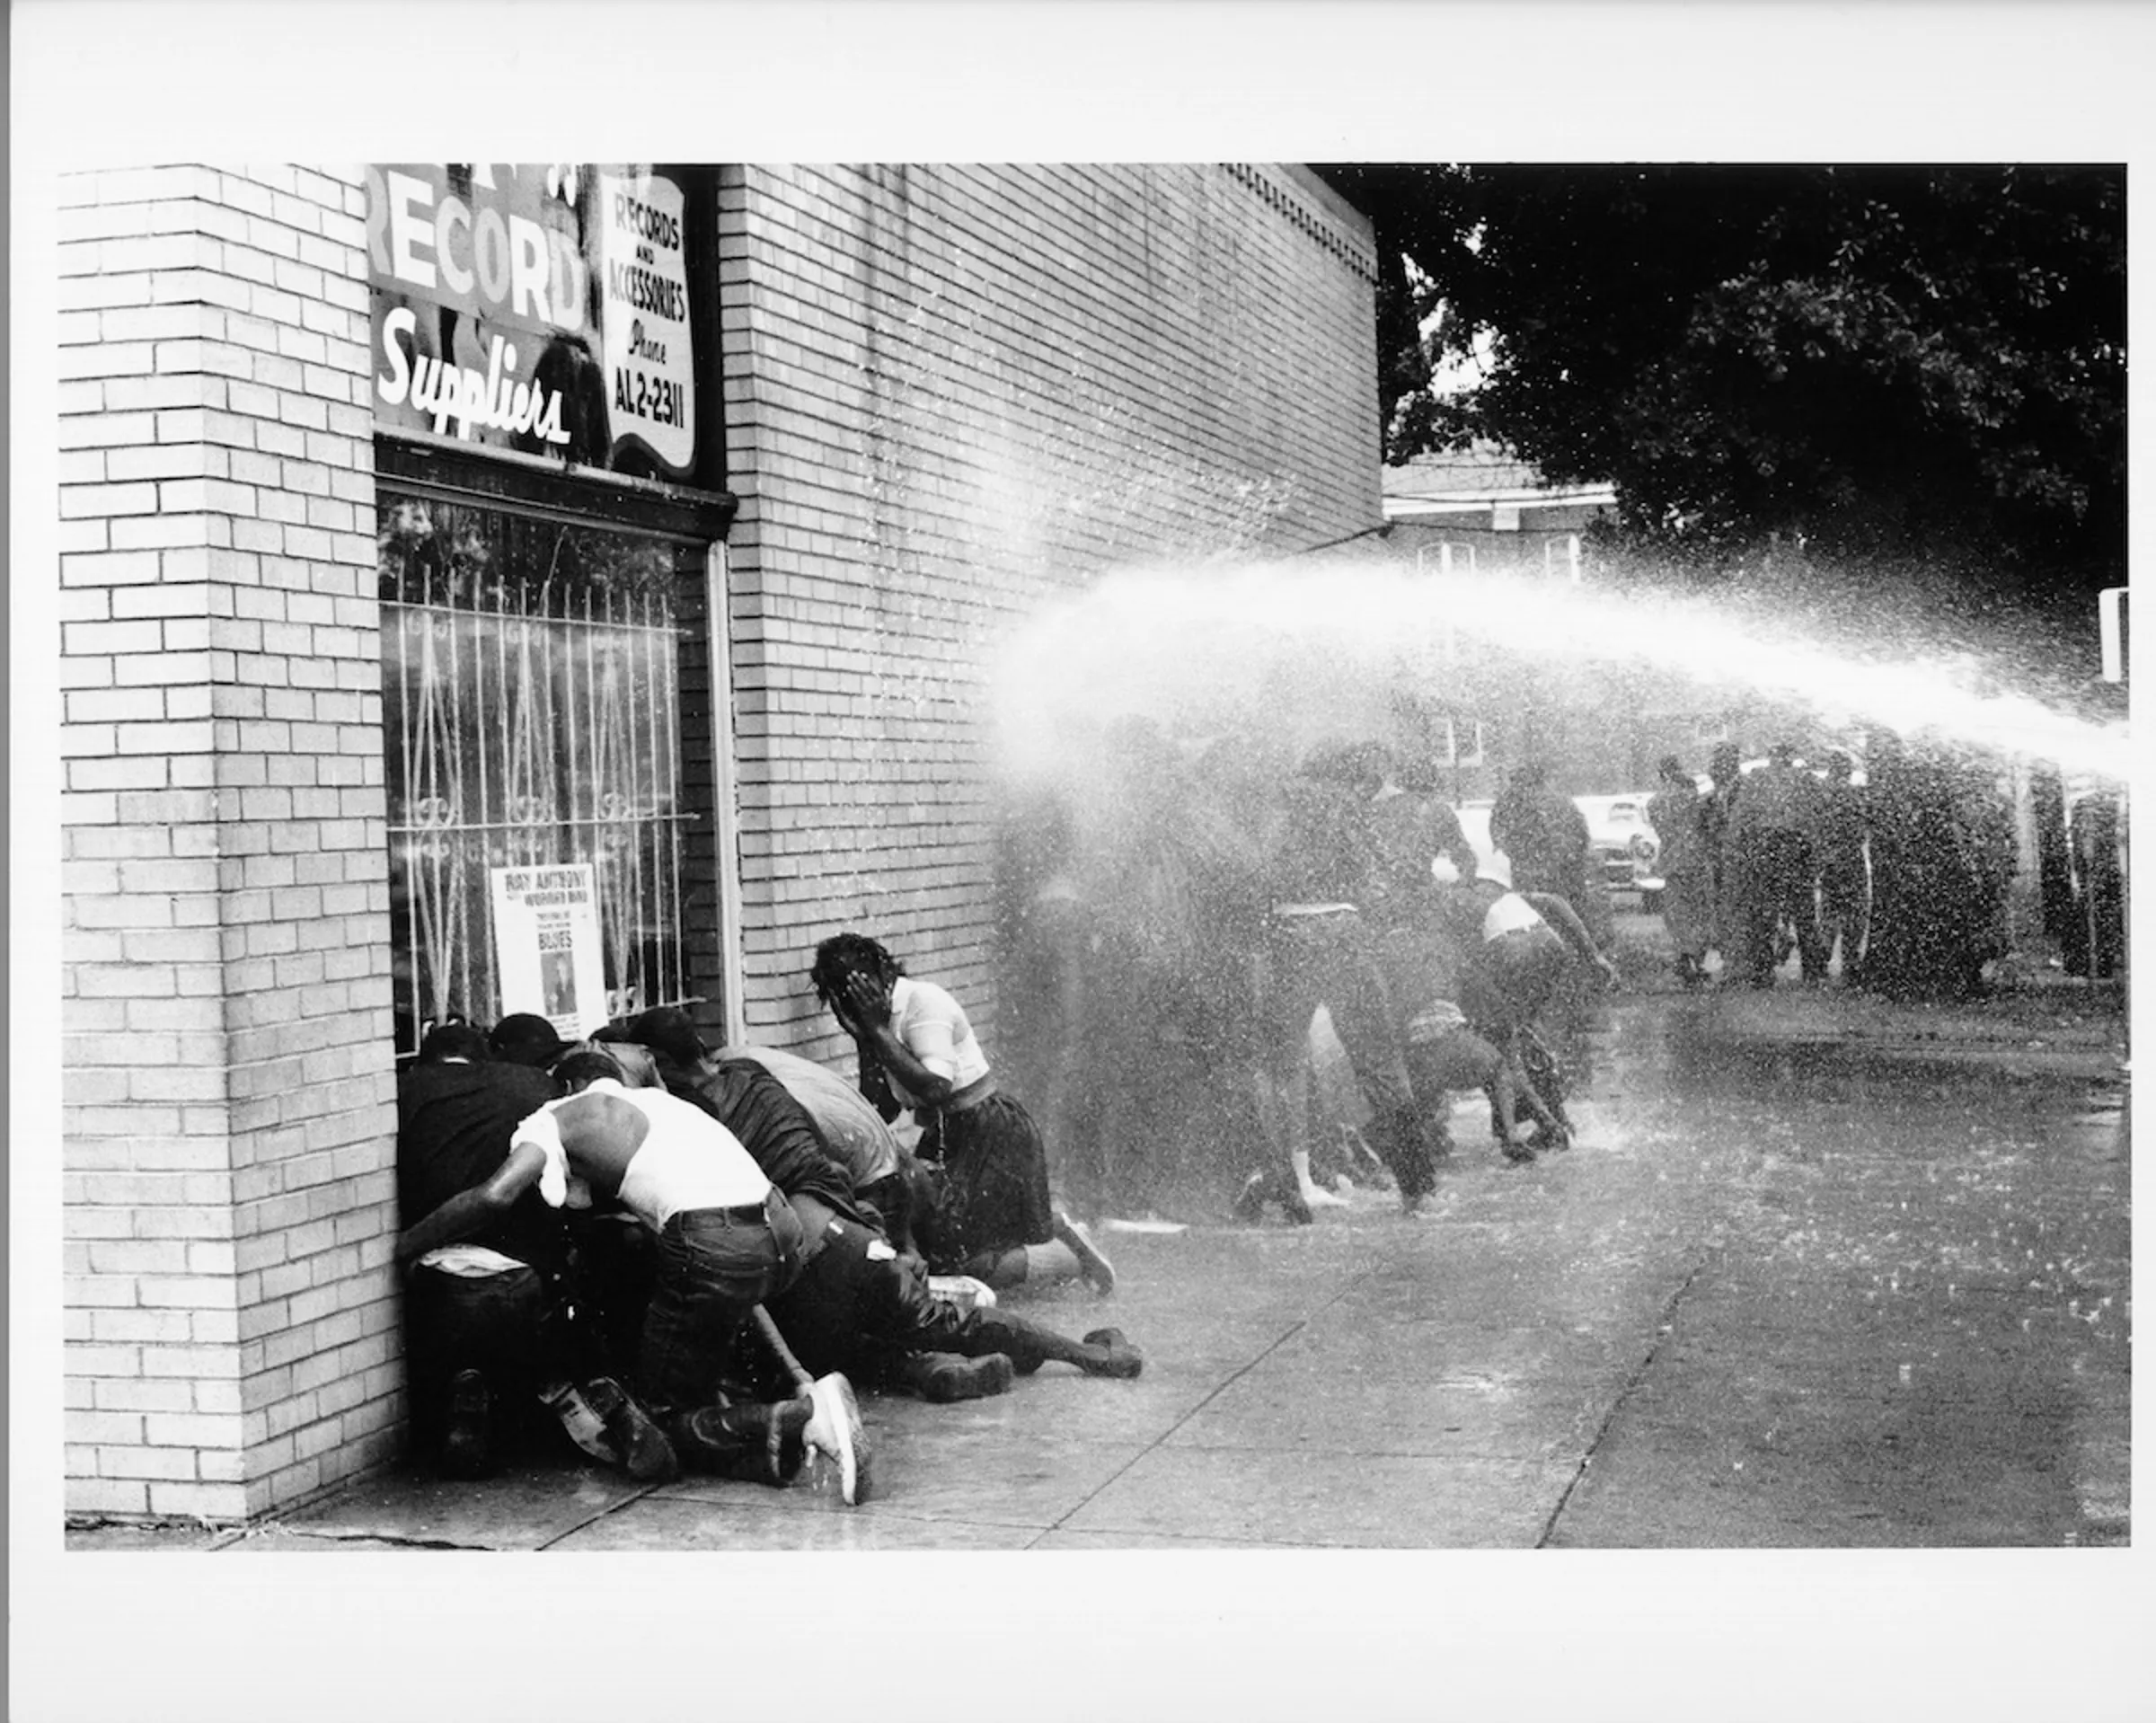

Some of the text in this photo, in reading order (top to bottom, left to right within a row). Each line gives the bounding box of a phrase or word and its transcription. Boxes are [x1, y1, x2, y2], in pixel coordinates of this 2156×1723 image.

[614, 192, 680, 251] RECORDS
[636, 244, 654, 265] AND
[609, 258, 685, 323] ACCESSORIES
[628, 318, 667, 365] Phone
[378, 306, 571, 445] Suppliers
[539, 930, 572, 950] BLUES
